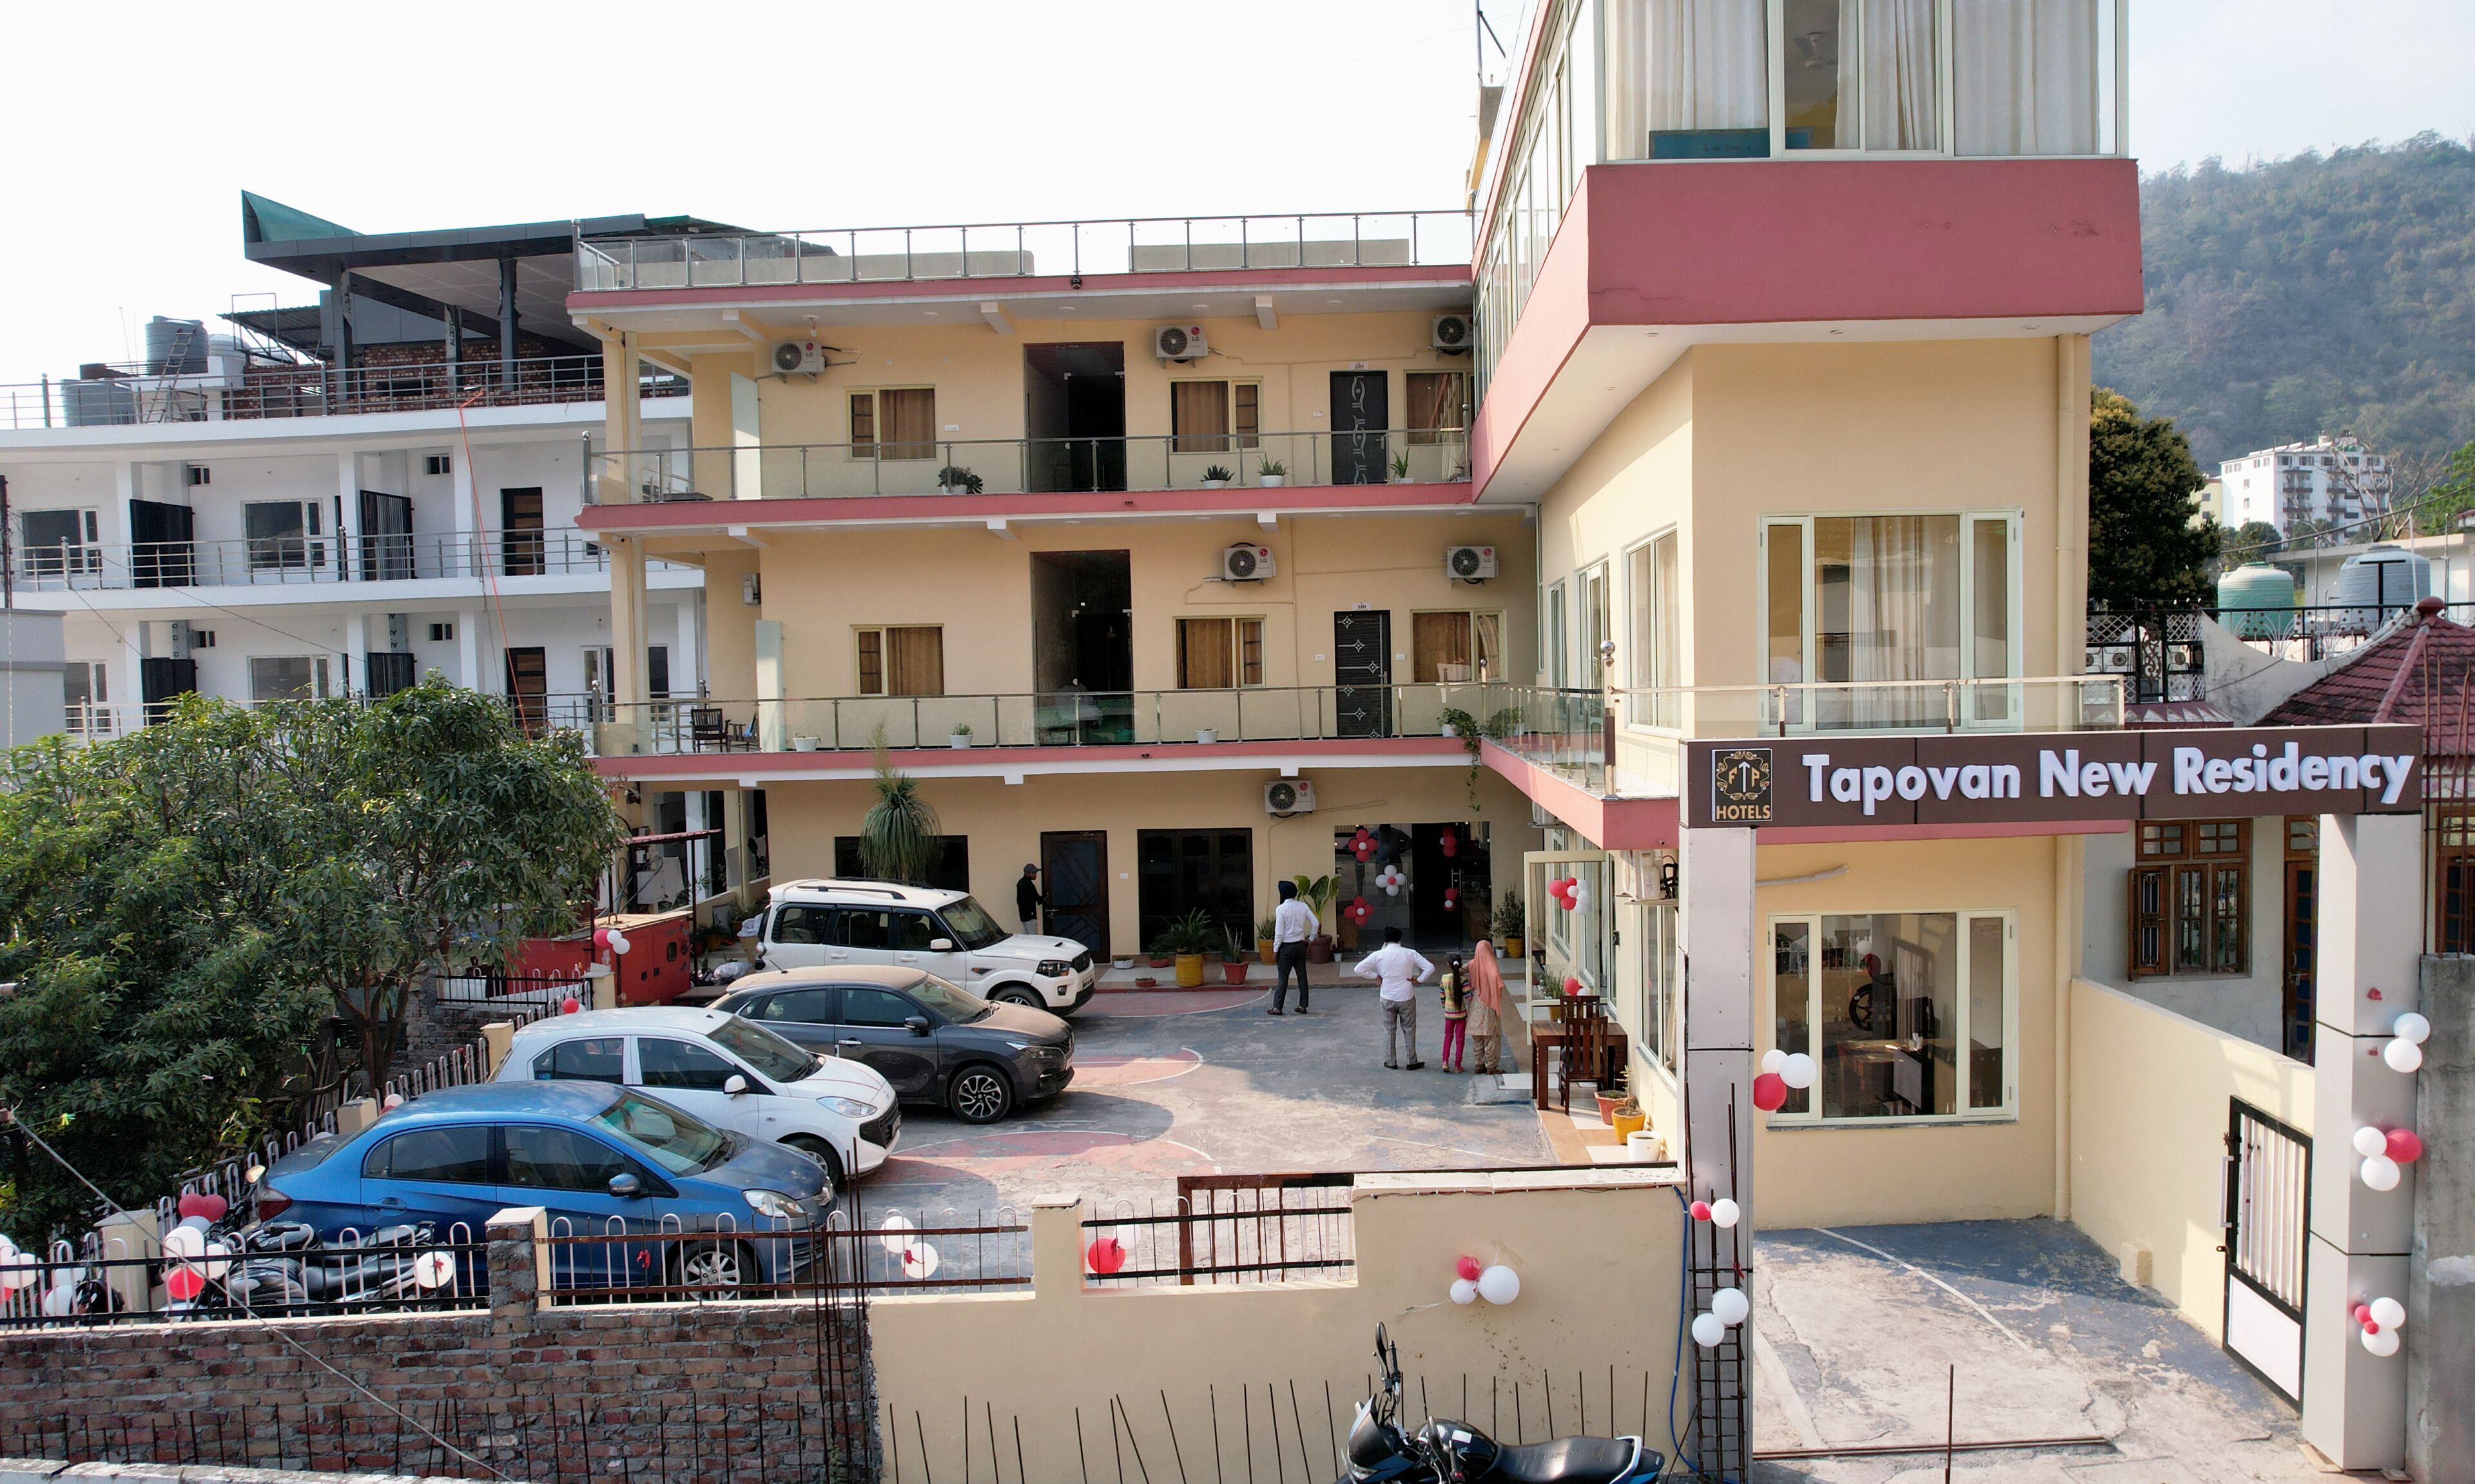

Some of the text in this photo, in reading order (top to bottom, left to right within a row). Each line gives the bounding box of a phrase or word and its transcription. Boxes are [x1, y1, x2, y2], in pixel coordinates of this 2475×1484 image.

[1802, 741, 2415, 816] Tapovan New Residency
[1716, 804, 1771, 820] HOTELS
